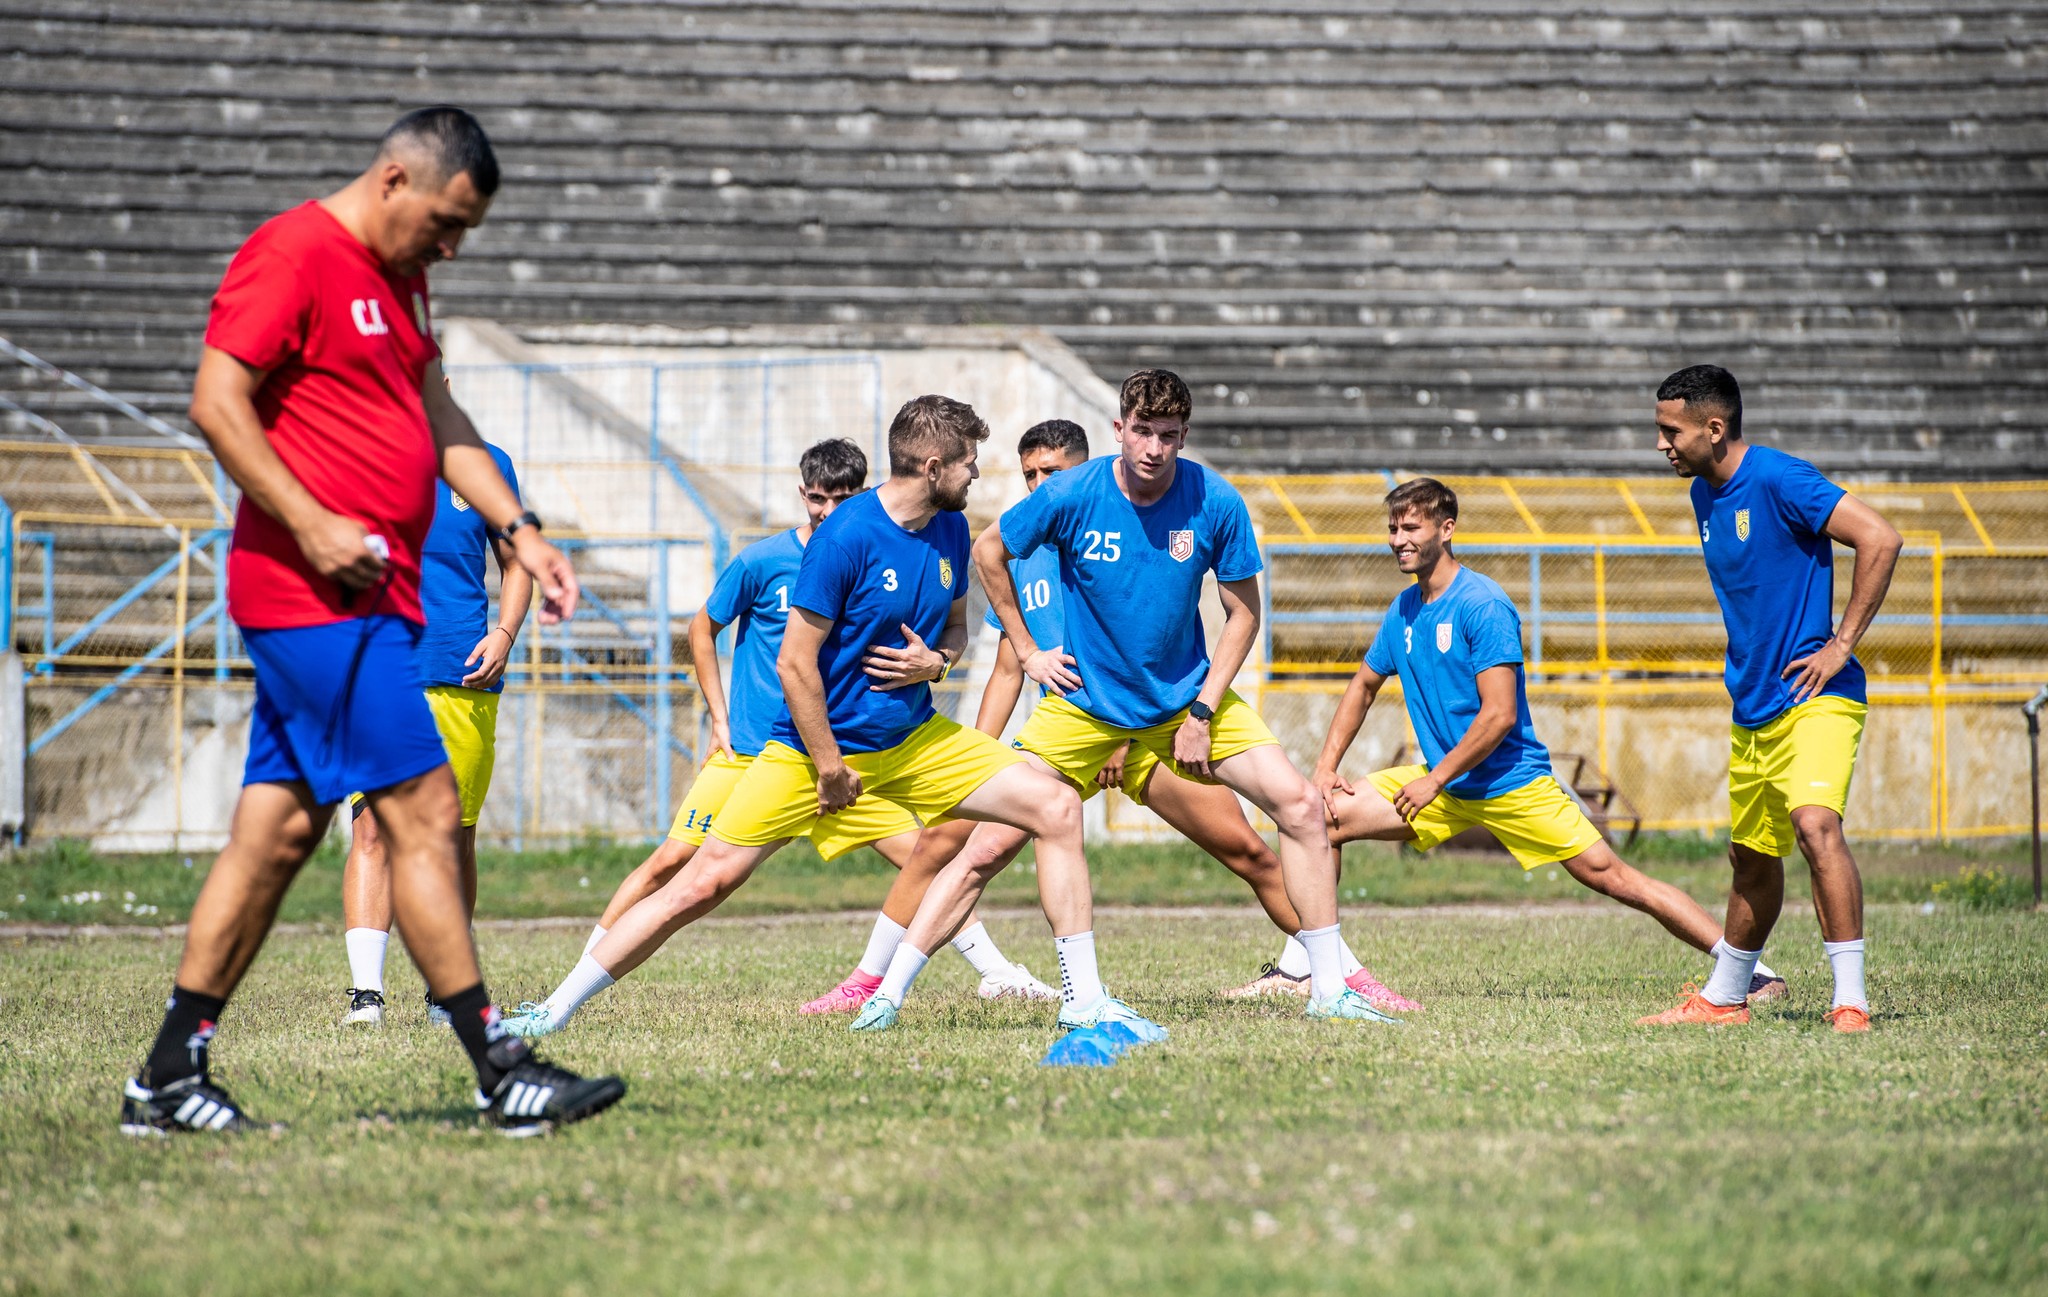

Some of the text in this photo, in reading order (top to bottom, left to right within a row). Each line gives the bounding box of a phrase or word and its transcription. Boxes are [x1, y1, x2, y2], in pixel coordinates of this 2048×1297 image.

[1702, 520, 1710, 543] 5
[1083, 529, 1121, 562] 25
[882, 568, 898, 592] 3
[775, 585, 792, 612] 1
[1022, 579, 1050, 612] 10
[1404, 625, 1413, 655] 3
[684, 809, 713, 833] 14
